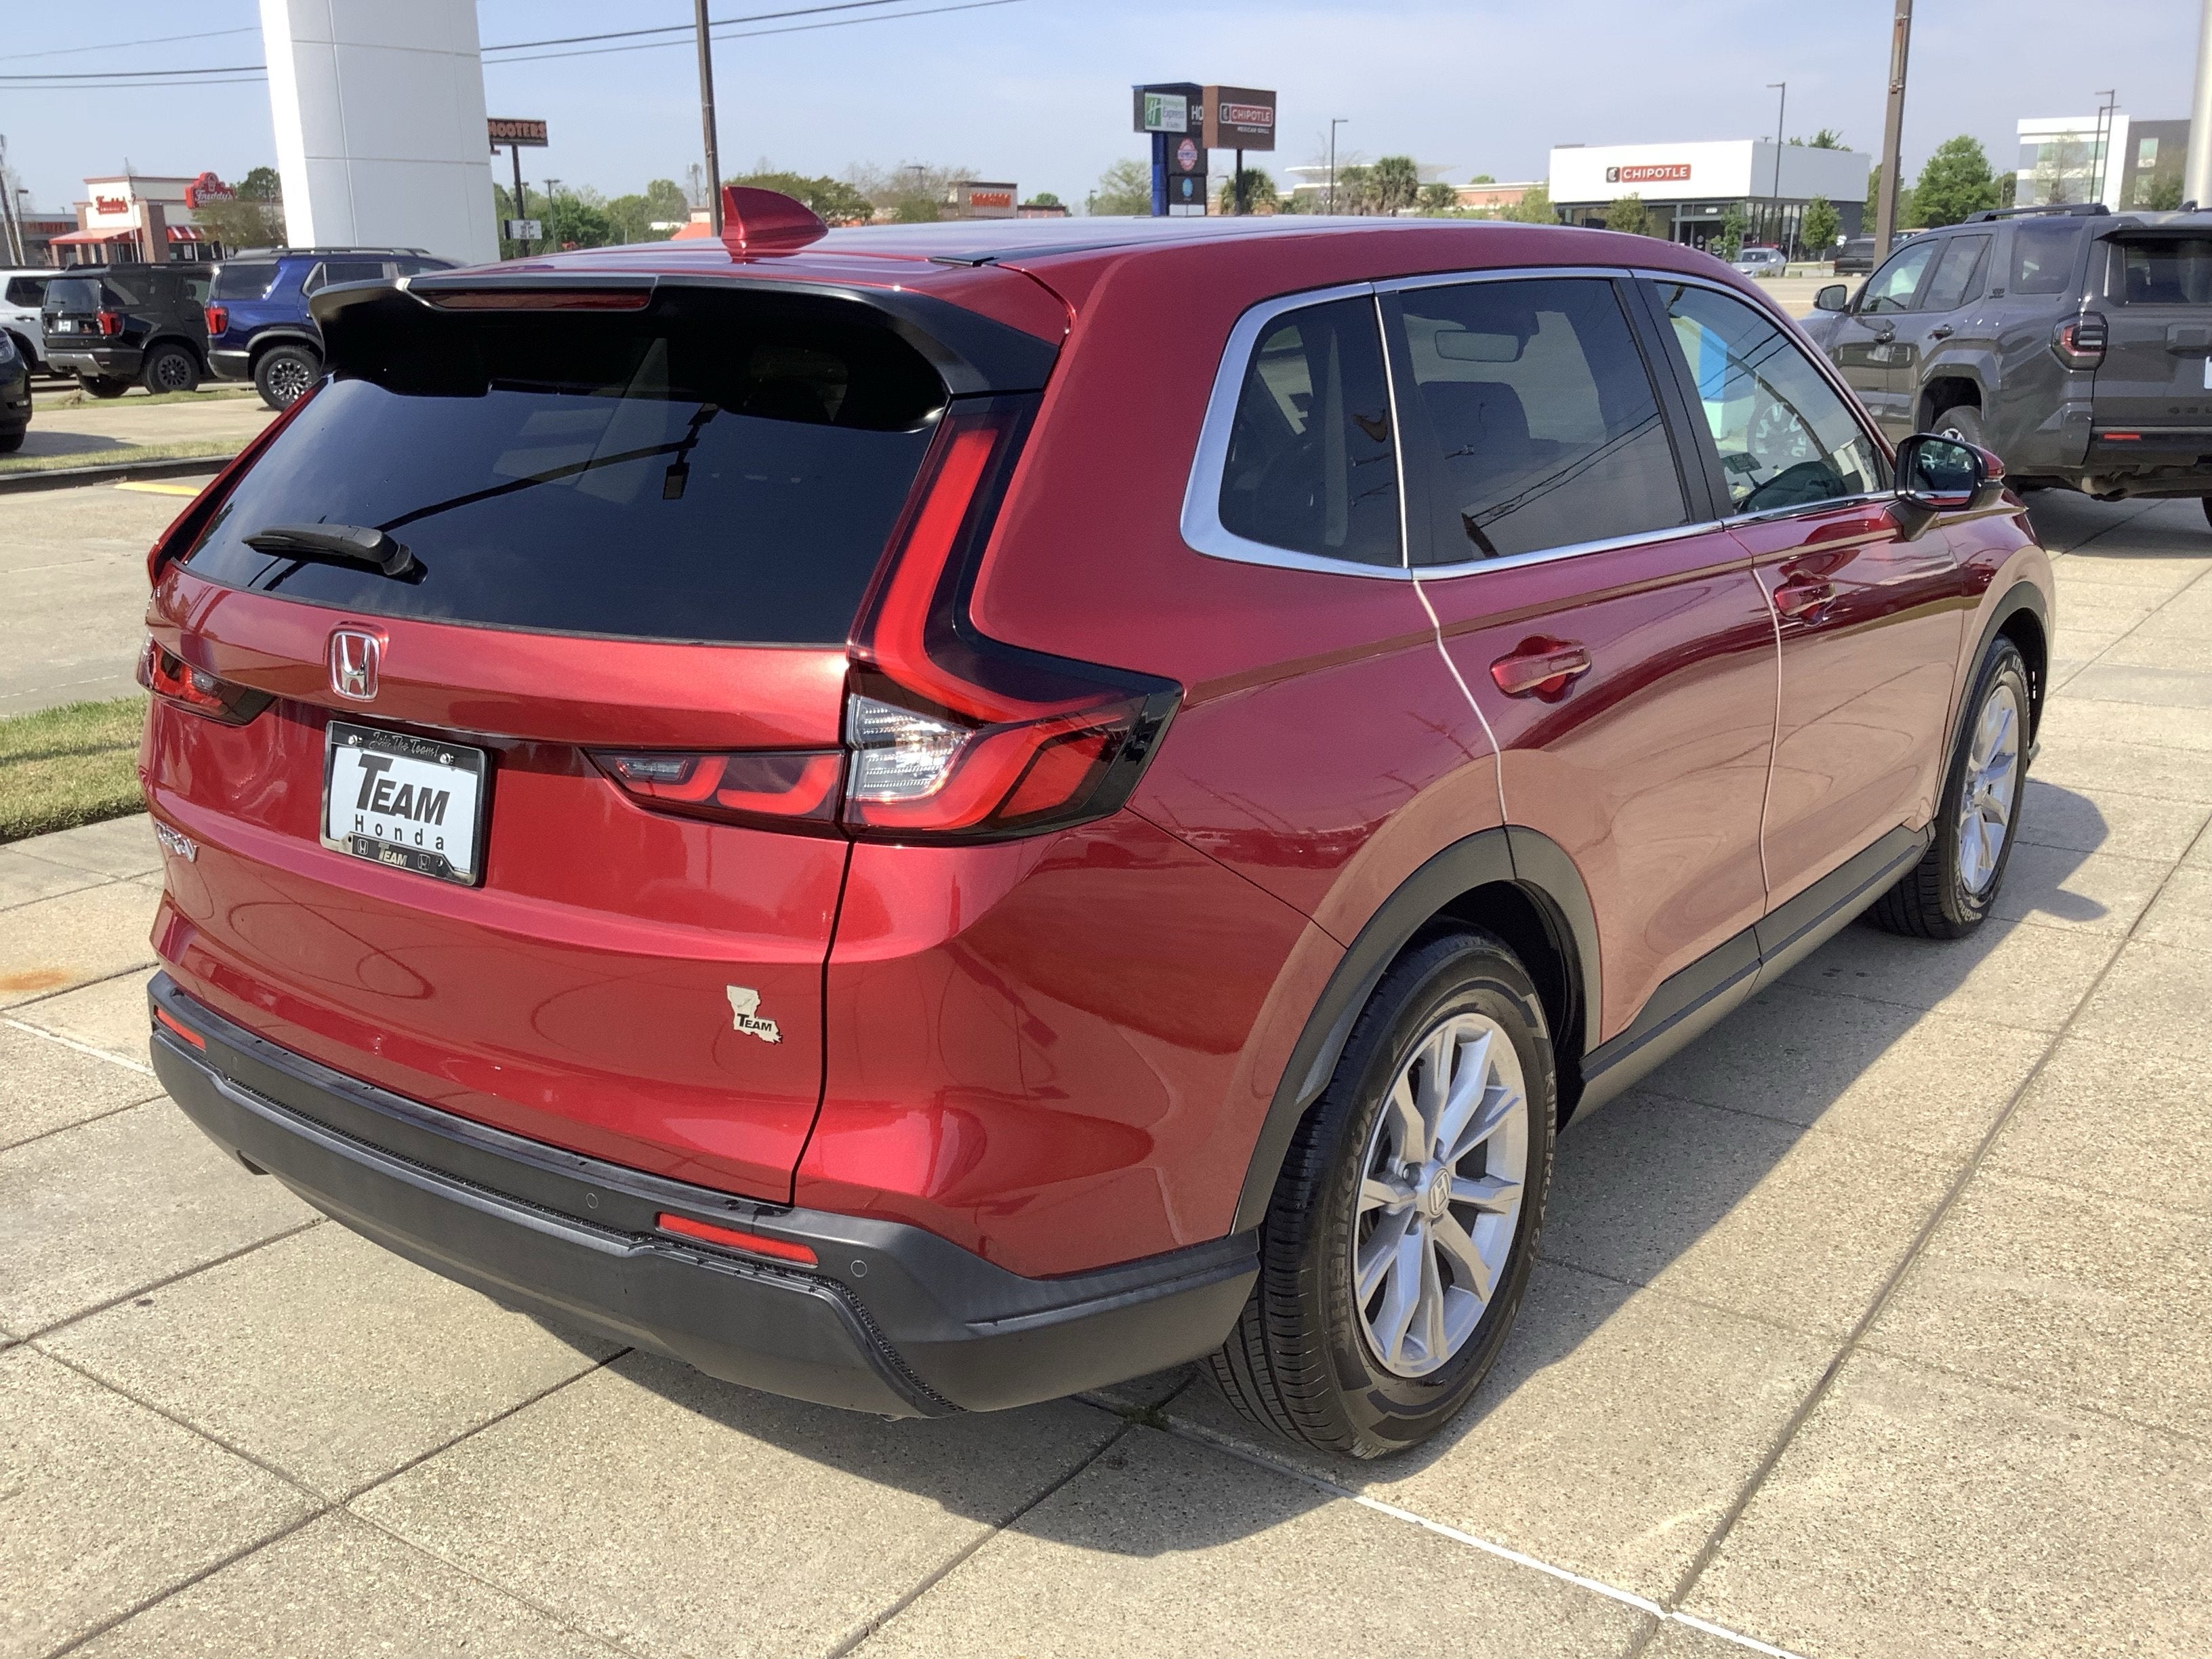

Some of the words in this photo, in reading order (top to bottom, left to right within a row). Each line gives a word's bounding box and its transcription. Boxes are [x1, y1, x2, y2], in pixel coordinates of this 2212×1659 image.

[1232, 109, 1271, 122] CHIPOTLE
[1623, 167, 1688, 179] CHIPOTLE
[392, 735, 409, 752] The
[410, 739, 440, 757] Team!
[356, 753, 450, 826] TEAM
[354, 814, 445, 851] Honda
[377, 842, 408, 867] TEAM
[737, 1013, 773, 1031] TEAM
